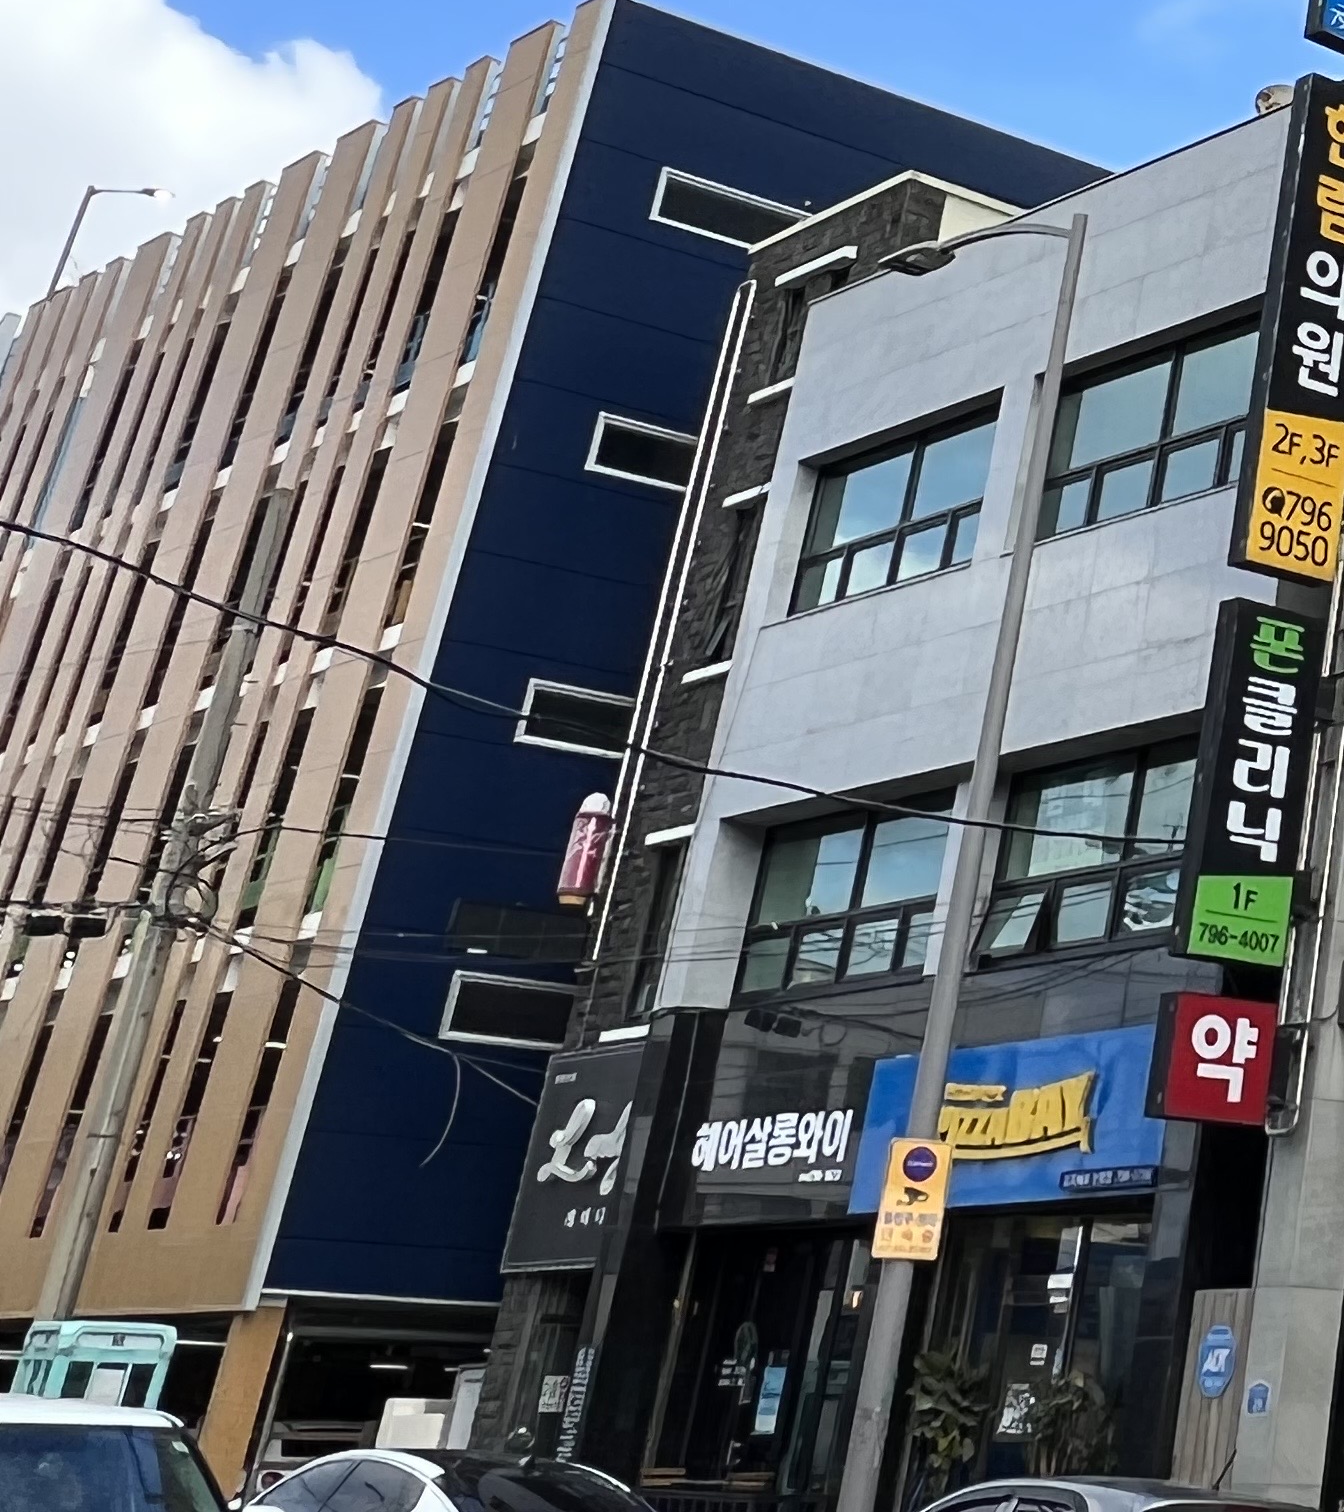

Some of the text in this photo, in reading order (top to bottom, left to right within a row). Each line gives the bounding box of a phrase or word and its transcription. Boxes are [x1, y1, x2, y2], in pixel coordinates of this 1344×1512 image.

[1286, 490, 1333, 531] 796
[1259, 521, 1328, 567] 9050
[1227, 615, 1305, 863] 폰클리닉
[1232, 881, 1257, 910] 1F
[1198, 922, 1280, 954] 796-4007
[1191, 1013, 1259, 1103] 약
[691, 1109, 854, 1171] 헤어살롱와이
[1201, 1348, 1231, 1374] ADT
